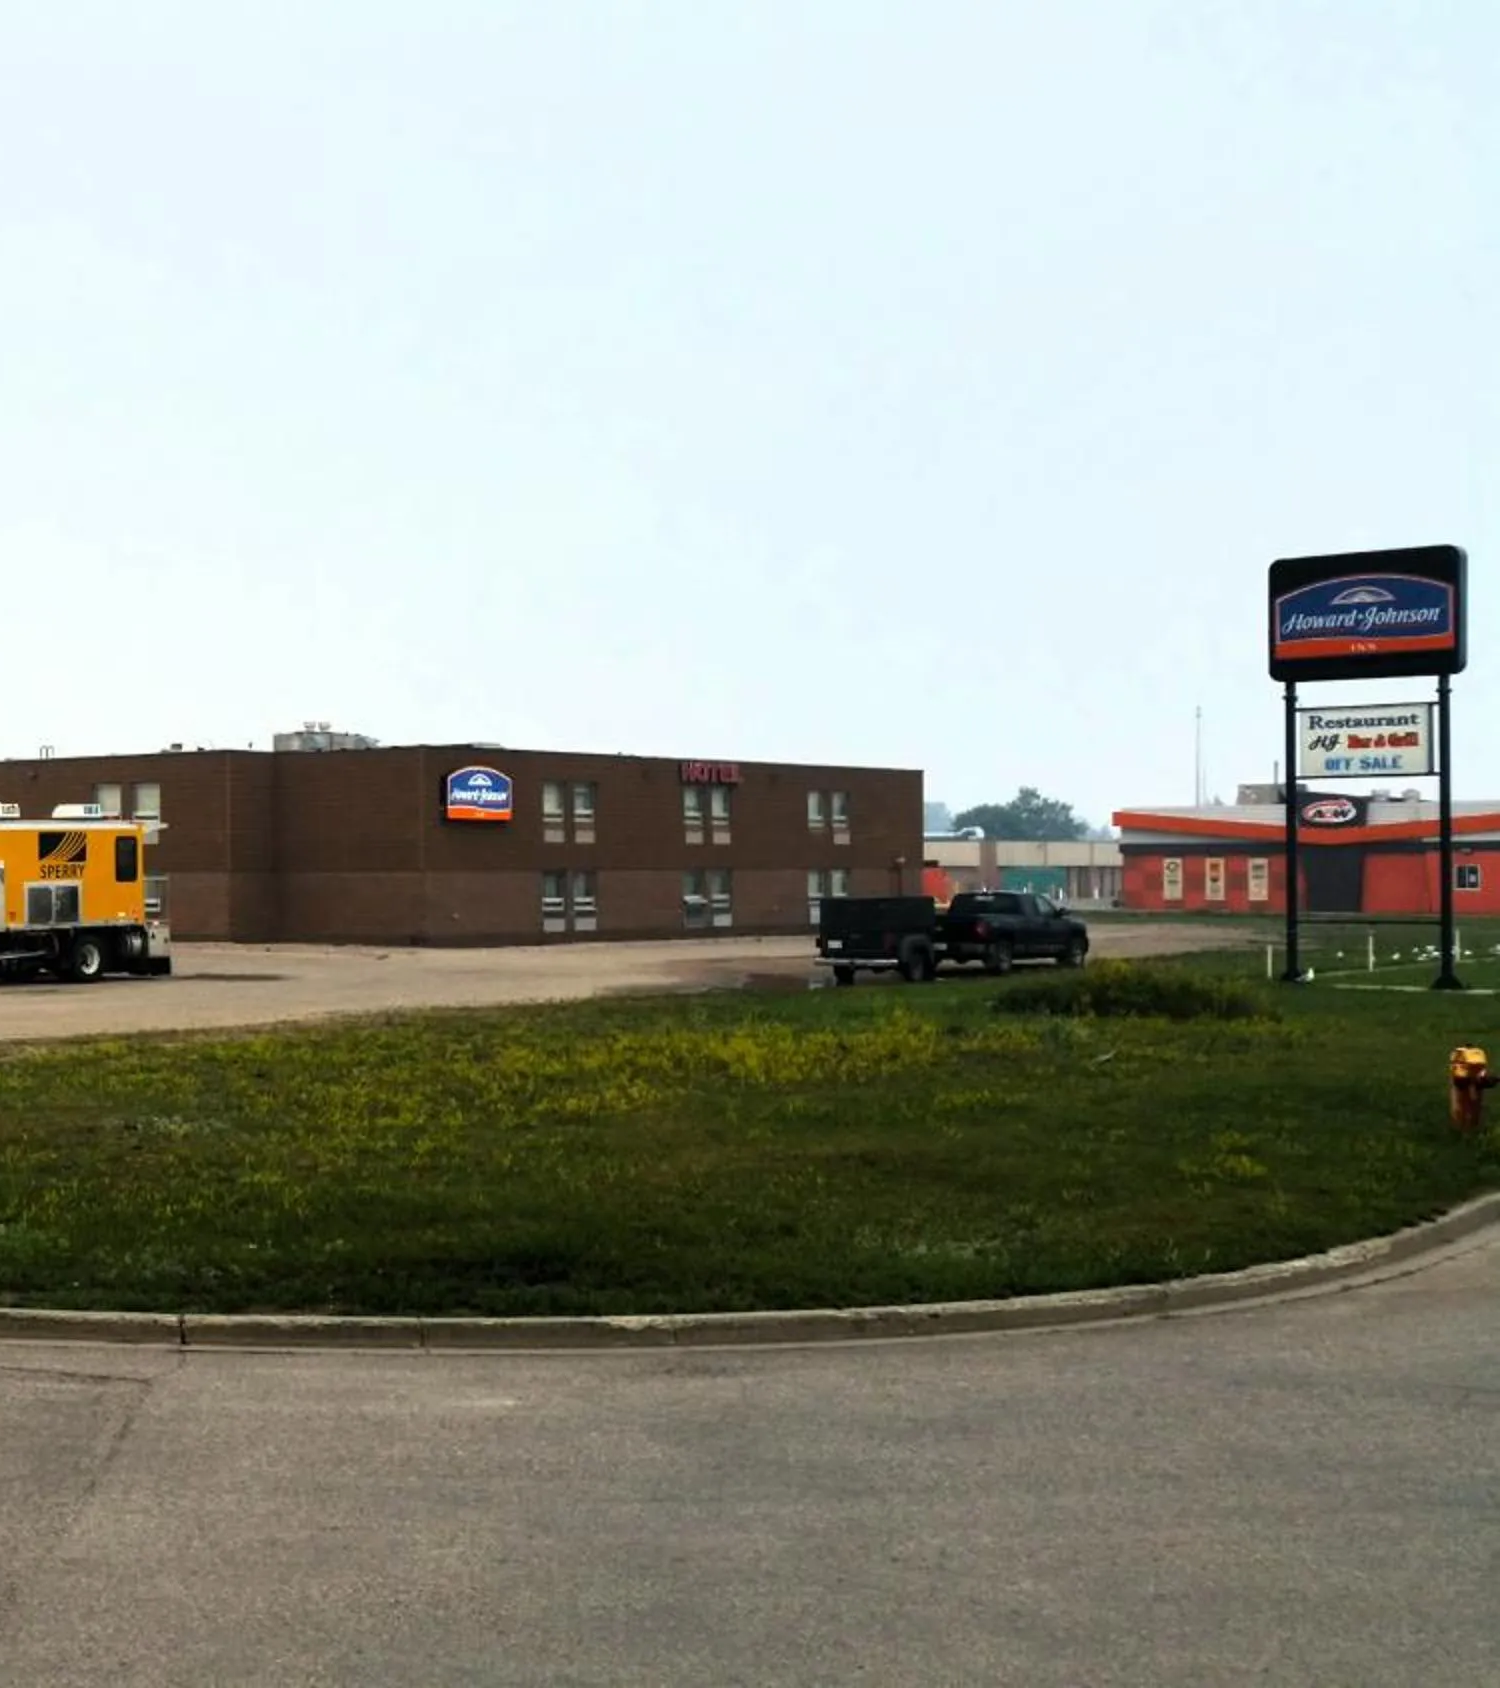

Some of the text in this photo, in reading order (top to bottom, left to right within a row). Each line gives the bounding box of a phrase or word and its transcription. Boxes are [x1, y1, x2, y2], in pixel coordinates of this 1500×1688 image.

[1308, 714, 1420, 730] Restaurant
[1360, 755, 1402, 769] SALE
[681, 761, 743, 784] HOTEL
[39, 863, 85, 879] SPERRY
